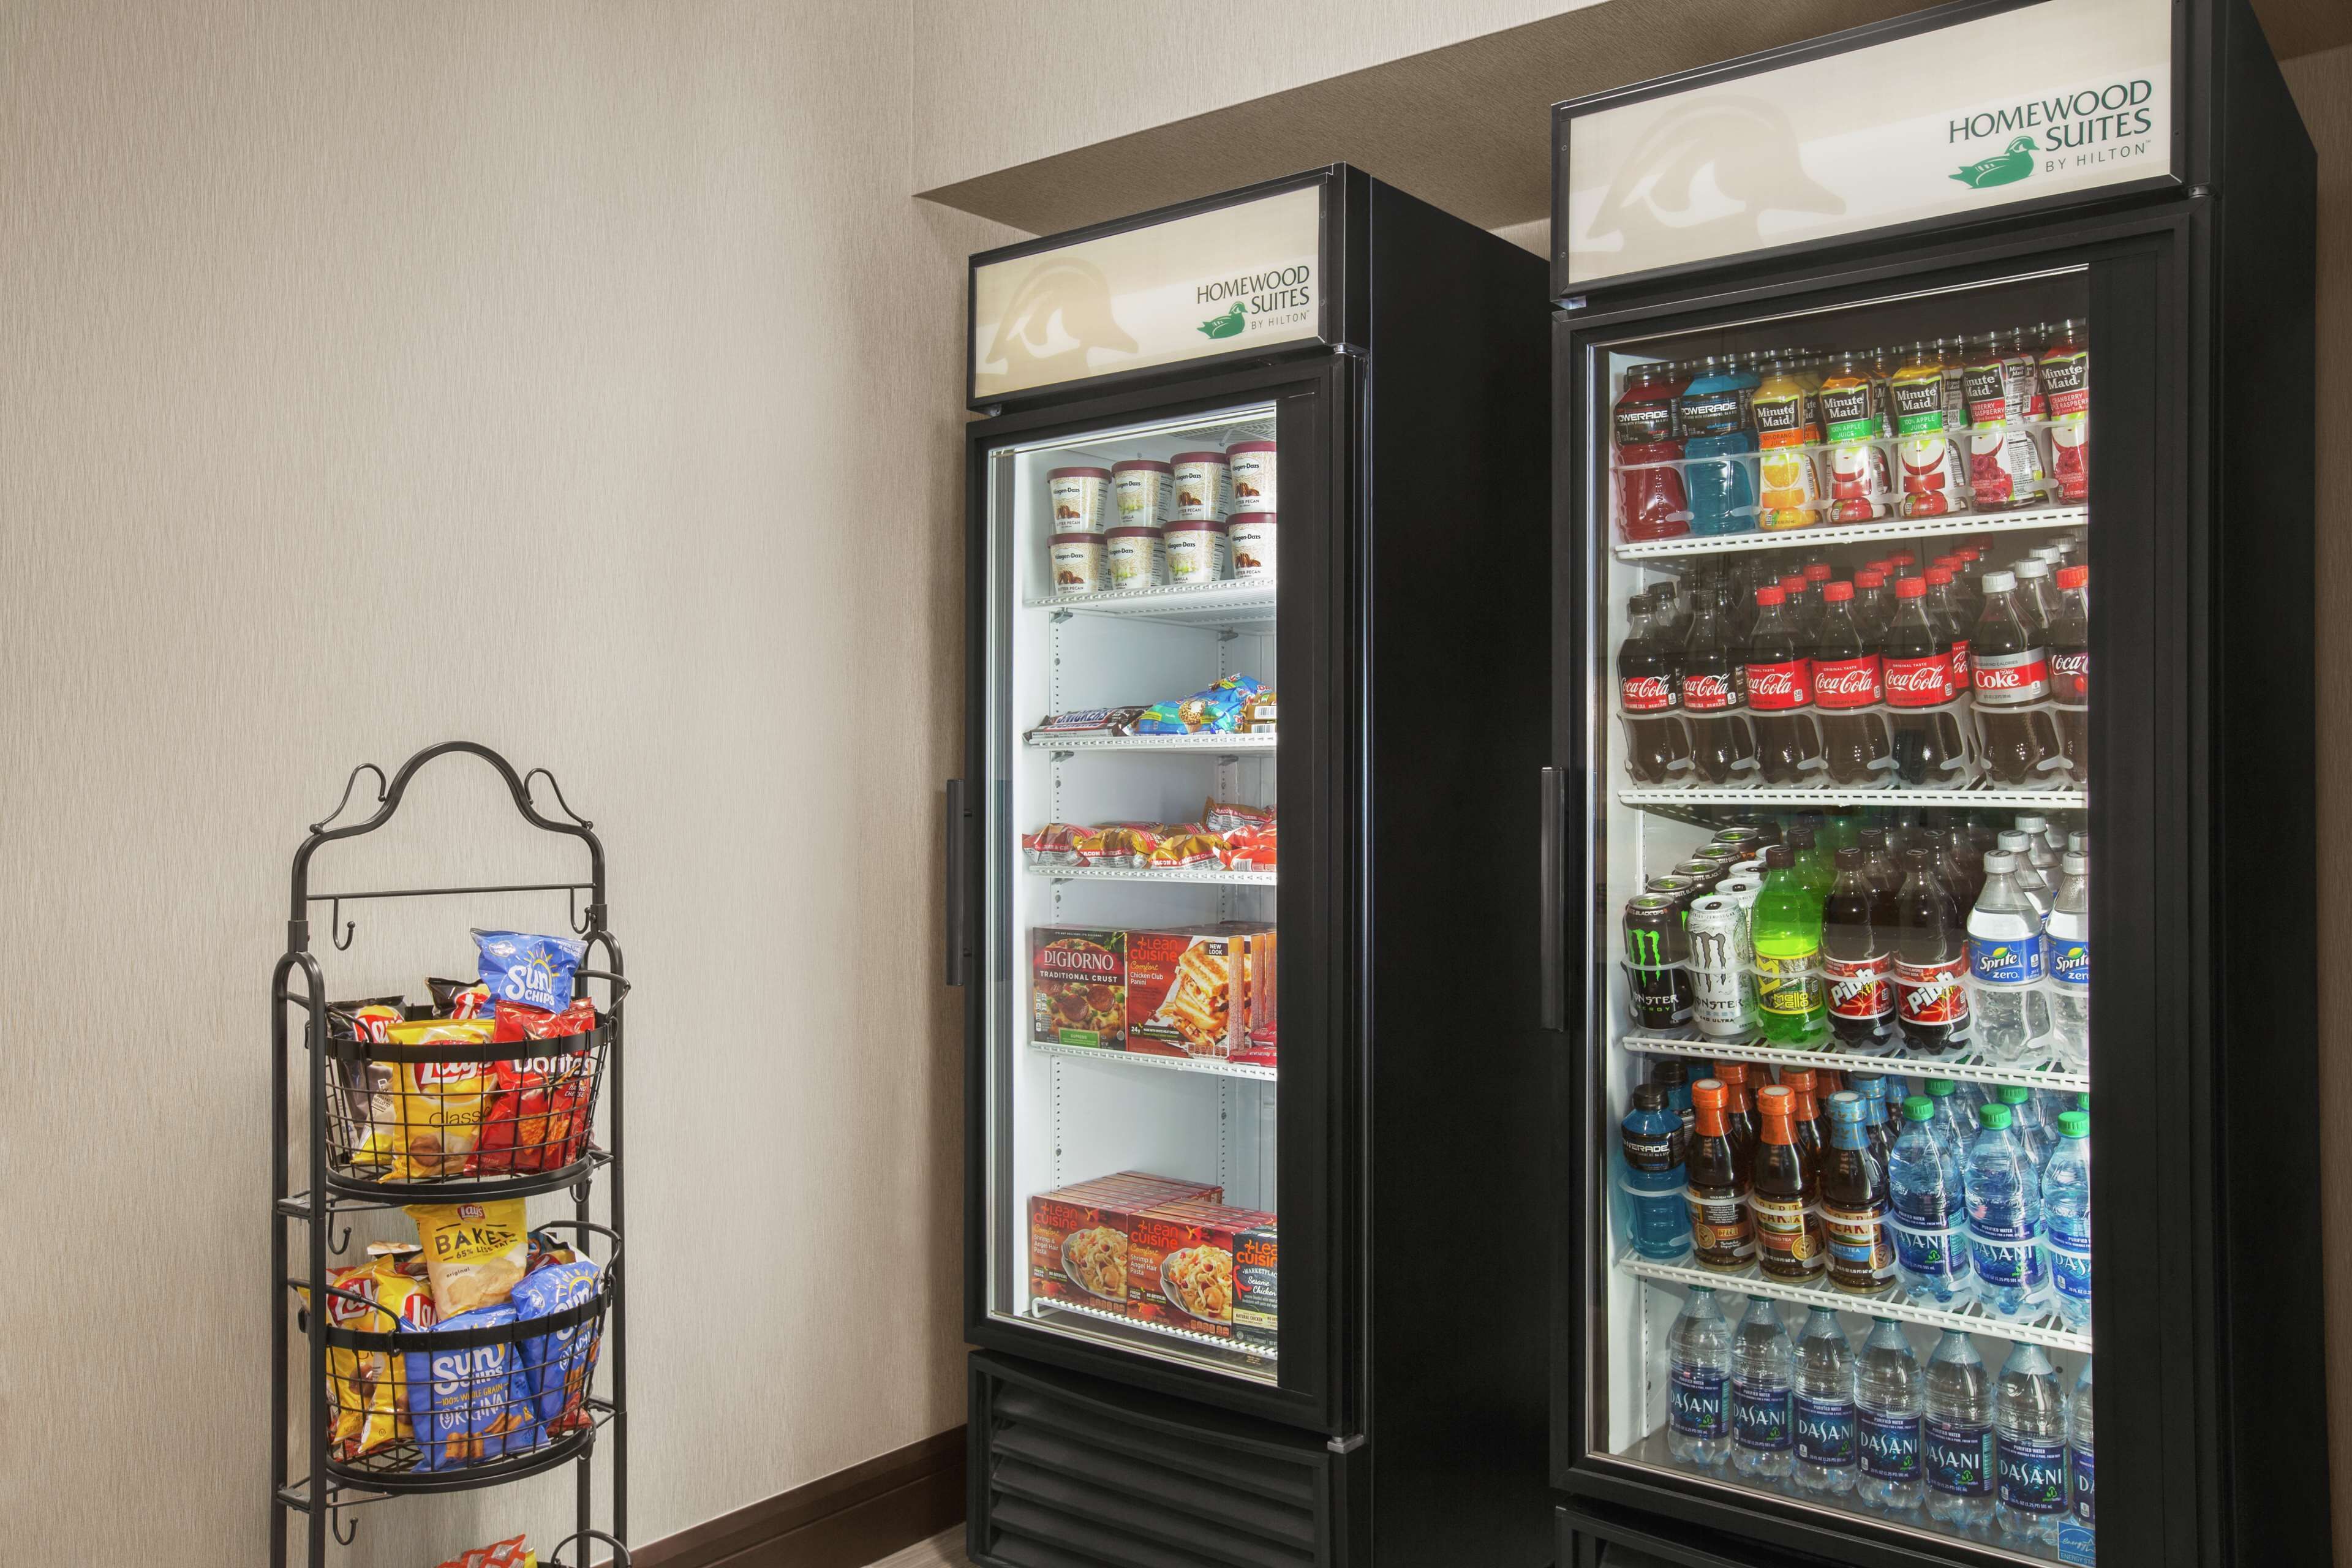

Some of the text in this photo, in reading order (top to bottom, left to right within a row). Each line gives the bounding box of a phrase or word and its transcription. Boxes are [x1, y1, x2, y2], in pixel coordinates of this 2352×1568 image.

[1950, 80, 2152, 143] HOMEWOOD
[2046, 108, 2152, 151] SUITES
[2046, 143, 2145, 172] BY HILTON
[1197, 265, 1310, 304] HOMEWOOD
[1251, 286, 1310, 314] SUITES
[1251, 312, 1306, 330] BY HILTON
[2042, 364, 2082, 378] Minute
[2048, 375, 2078, 390] Maid
[1897, 387, 1937, 401] Minute
[1824, 396, 1864, 409] Minute
[1902, 398, 1932, 411] Maid
[1757, 405, 1795, 418] Minute
[1830, 405, 1860, 418] Maid
[1973, 407, 2004, 417] RASPBERRY
[1762, 416, 1790, 427] Maid
[1815, 667, 1874, 694] Coca-Cola
[1886, 664, 1945, 692] Coca-Cola
[1976, 670, 2019, 688] Coke
[1131, 961, 1158, 971] Comfort
[1980, 951, 2017, 972] Sprite
[505, 965, 551, 1001] Sun
[1040, 971, 1088, 981] TRADITIONAL
[525, 989, 555, 1006] CHIPS
[1774, 993, 1808, 1003] mello
[568, 1082, 587, 1091] NAHO
[429, 1106, 491, 1128] Classc
[461, 1206, 483, 1218] Lay's
[1034, 1234, 1050, 1243] Shrimp
[1034, 1240, 1048, 1249] Angel
[456, 1248, 473, 1259] 65%
[494, 1240, 508, 1249] FAT
[1131, 1243, 1158, 1256] Comfort
[1255, 1242, 1277, 1256] Lea
[1131, 1254, 1148, 1264] Shrimp
[1131, 1261, 1145, 1270] Angel
[447, 1267, 470, 1278] original
[1248, 1276, 1270, 1286] Sesame
[1253, 1286, 1277, 1296] Chicken
[432, 1347, 504, 1395] Sun
[442, 1383, 503, 1406] 100% WOLE GRAIN
[1671, 1390, 1719, 1413] DASANI
[1733, 1403, 1785, 1426] DASANI
[1799, 1419, 1853, 1443] DASANI
[1932, 1428, 1948, 1436] PURIFIED
[1861, 1431, 1917, 1456] DASANI
[2000, 1460, 2061, 1486] DASANI
[2061, 1551, 2082, 1562] ENERGY
